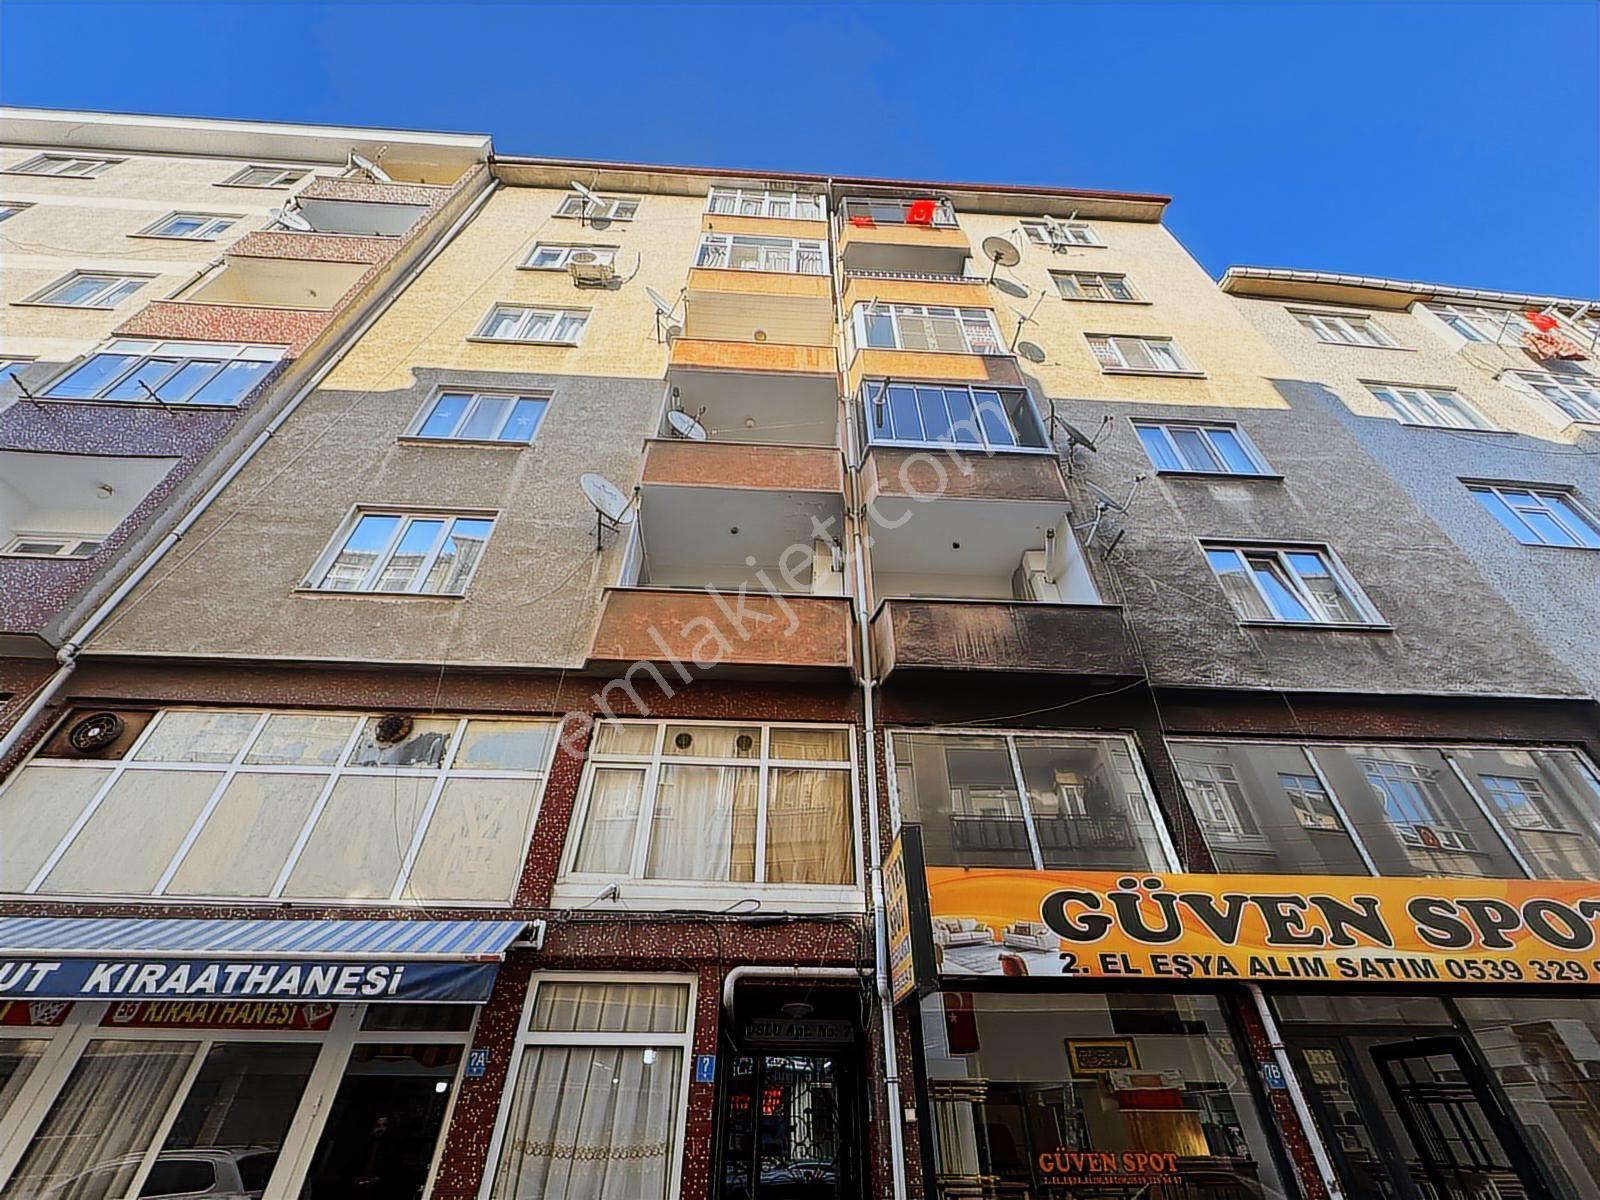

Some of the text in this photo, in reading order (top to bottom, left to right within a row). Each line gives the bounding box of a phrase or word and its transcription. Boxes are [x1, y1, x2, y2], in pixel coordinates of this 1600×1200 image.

[1041, 877, 1394, 948] GÜVEN
[1058, 953, 1090, 974] 2.
[1102, 954, 1142, 975] EL
[1150, 954, 1239, 980] EŞYA
[1250, 956, 1329, 978] ALIM
[1339, 956, 1440, 980] SATIM
[1445, 959, 1523, 981] 0539
[1528, 960, 1588, 981] 329
[1039, 1147, 1178, 1173] GÜVEN SPOT
